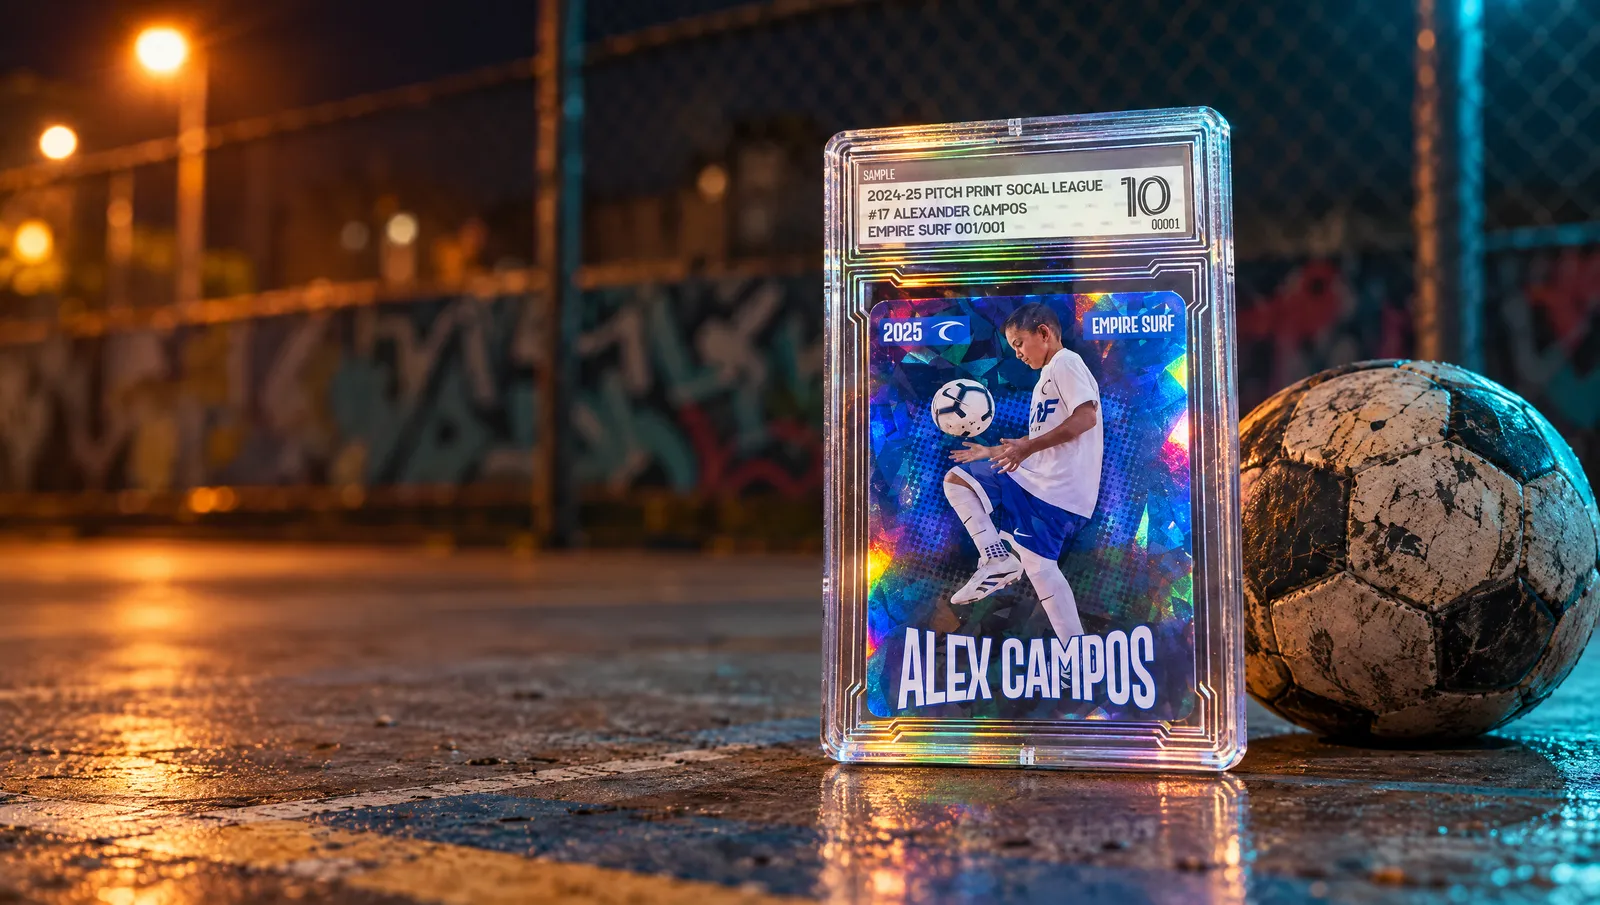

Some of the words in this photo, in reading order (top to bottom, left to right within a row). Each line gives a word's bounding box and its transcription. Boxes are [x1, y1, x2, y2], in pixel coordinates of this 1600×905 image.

[863, 168, 896, 181] SAMPLE
[867, 188, 922, 202] 2024-25
[925, 186, 963, 200] PITCH
[966, 184, 1003, 198] PRINT
[1006, 182, 1049, 197] SOCAL
[1052, 179, 1104, 195] LEAGUE
[1120, 175, 1172, 218] 10
[868, 208, 890, 221] #17
[893, 205, 970, 220] ALEXANDER
[973, 202, 1028, 216] CAMPOS
[868, 225, 915, 239] EMPIRE
[918, 223, 952, 237] SURF
[954, 221, 1006, 235] 001/001
[1151, 218, 1180, 231] 00001
[883, 321, 923, 343] 2025
[1092, 316, 1139, 336] EMPIRE
[1141, 314, 1176, 334] SURF
[897, 626, 993, 710] ALEX
[1001, 625, 1156, 710] CAMPOS
